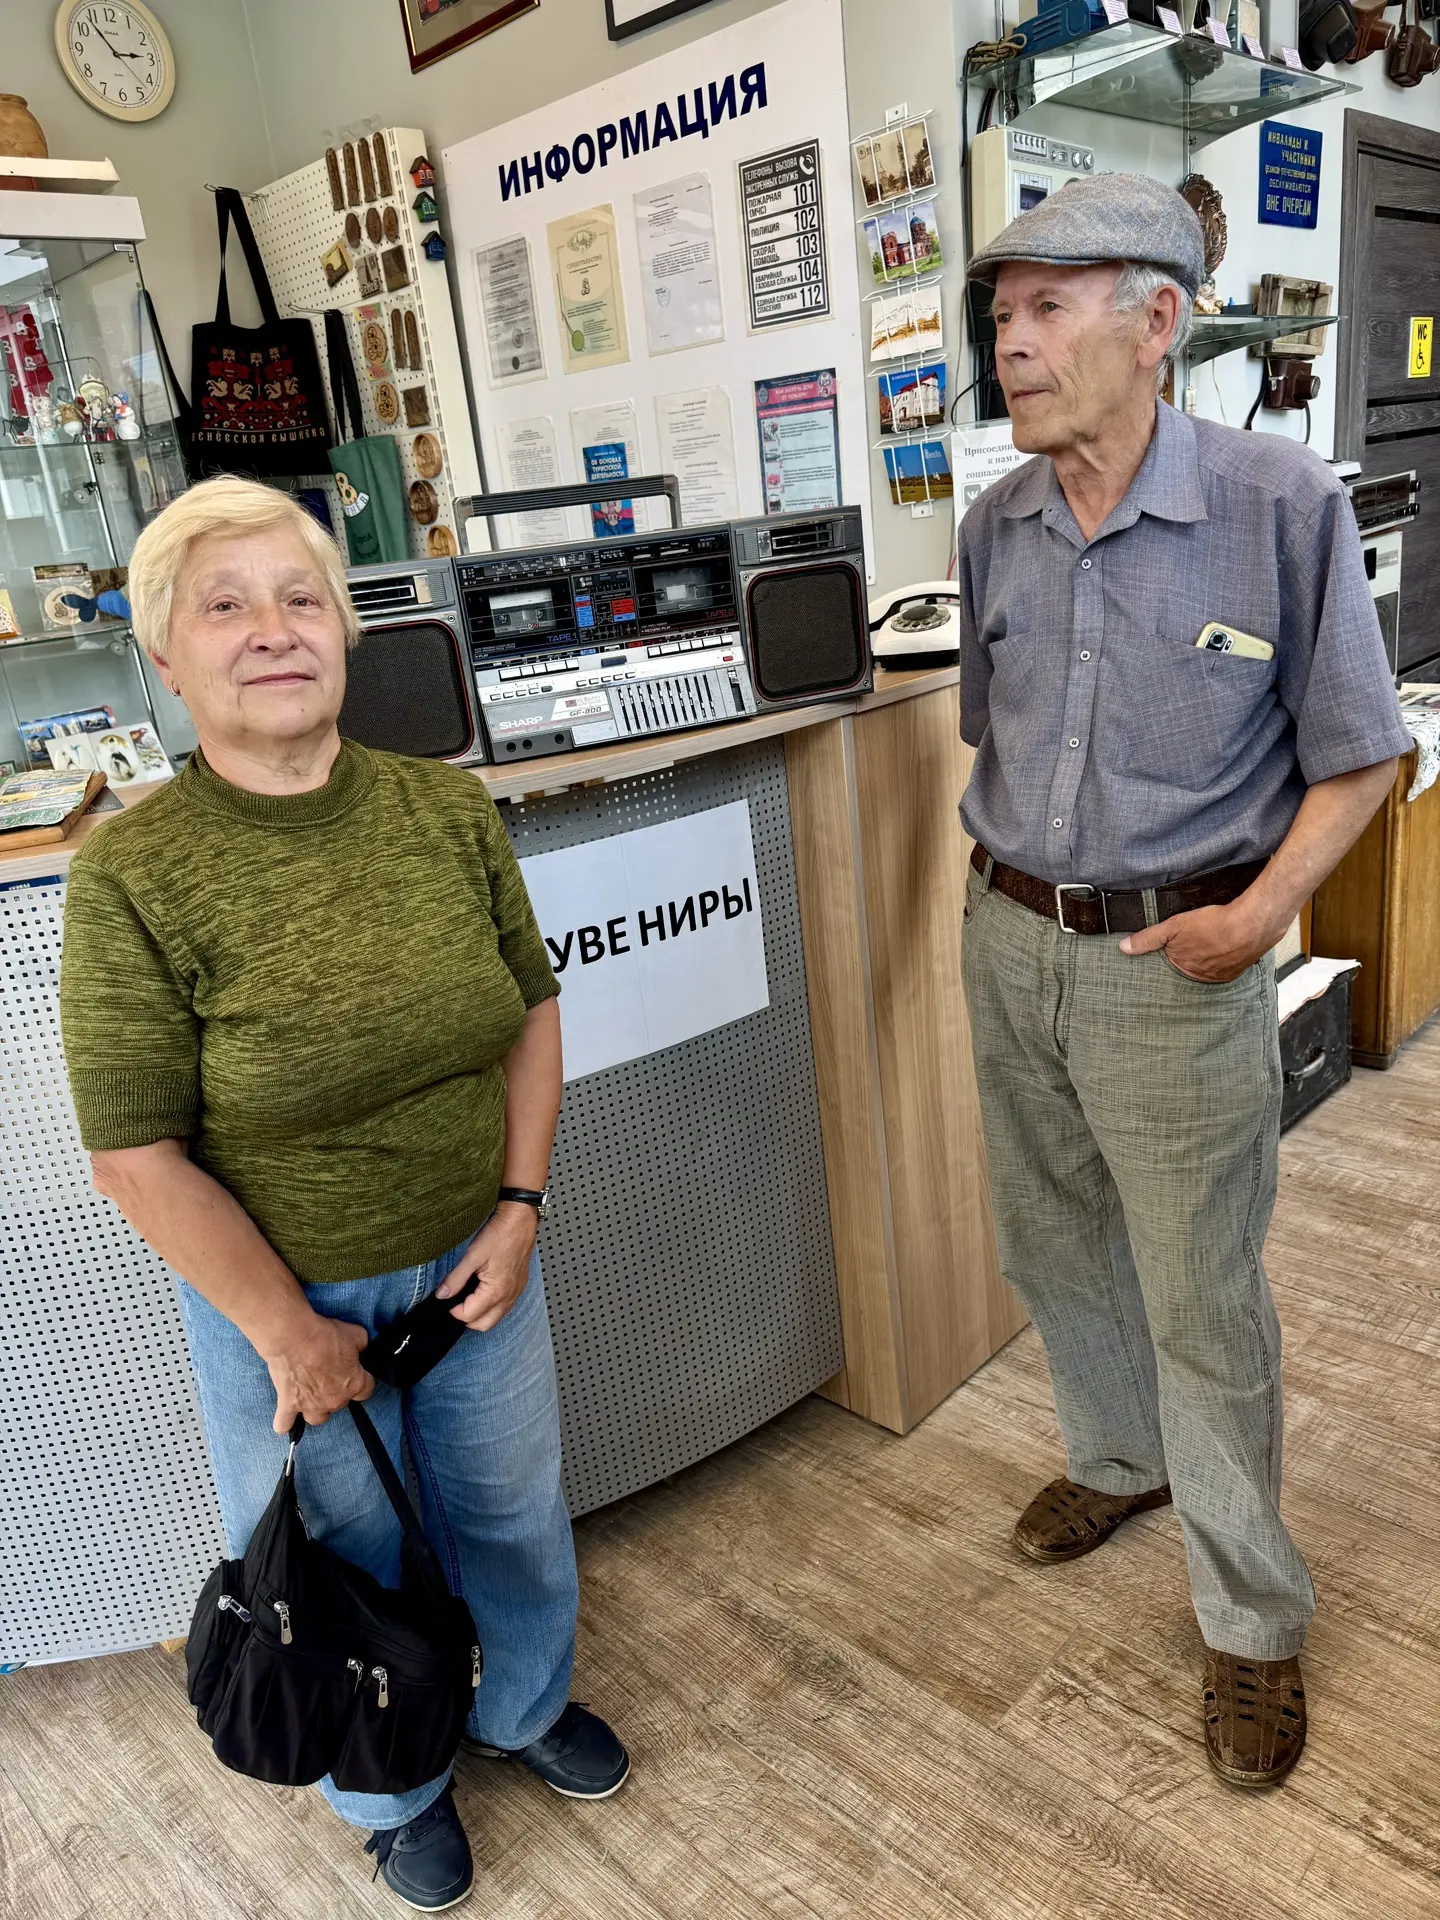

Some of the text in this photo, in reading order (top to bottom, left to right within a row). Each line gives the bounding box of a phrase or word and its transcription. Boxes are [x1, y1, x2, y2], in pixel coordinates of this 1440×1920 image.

[87, 8, 98, 23] 11
[103, 8, 117, 23] 12
[126, 15, 131, 29] 1
[77, 21, 90, 37] 10
[138, 31, 147, 46] 2
[74, 41, 84, 56] 9
[146, 52, 155, 66] 3
[84, 63, 93, 78] 8
[146, 73, 154, 86] 4
[100, 81, 107, 95] 7
[118, 87, 128, 101] 6
[136, 87, 145, 100] 5
[498, 62, 768, 202] ИНФОРМАЦИЯ
[1267, 131, 1309, 150] ИНВАЛИДЫ И
[1281, 149, 1316, 167] УЧАСТНИКИ
[744, 157, 798, 181] ТЕЛЕФОНЫ ВЫЗОВА
[745, 170, 799, 194] ЭКСТРЕННЫХ СЛУЖБ
[1269, 178, 1311, 193] ОБСЛУЖИВАЮТСЯ
[748, 191, 782, 208] ПОЖАРНАЯ
[794, 181, 815, 205] 101
[1266, 194, 1312, 216] ВНЕ ОЧЕРЕДИ
[751, 208, 816, 238] ПОЛИЦИЯ 102
[752, 244, 776, 258] СКОРАЯ
[796, 233, 818, 257] 103
[753, 253, 780, 267] ПОМОЩЬ
[755, 270, 782, 283] АВАРИЙНАЯ
[797, 259, 820, 282] 104
[755, 275, 798, 290] ГАЗОВАЯ СЛУЖБА
[756, 292, 798, 307] ЕДИНАЯ СЛУЖБА
[800, 285, 821, 307] 112
[758, 303, 781, 314] СПАСЕНИЯ
[1417, 324, 1428, 340] WC
[995, 455, 1012, 464] нам
[965, 467, 1017, 479] социальн
[704, 607, 735, 618] TAPE 2
[547, 633, 572, 643] TAPE
[499, 716, 544, 730] SHARP
